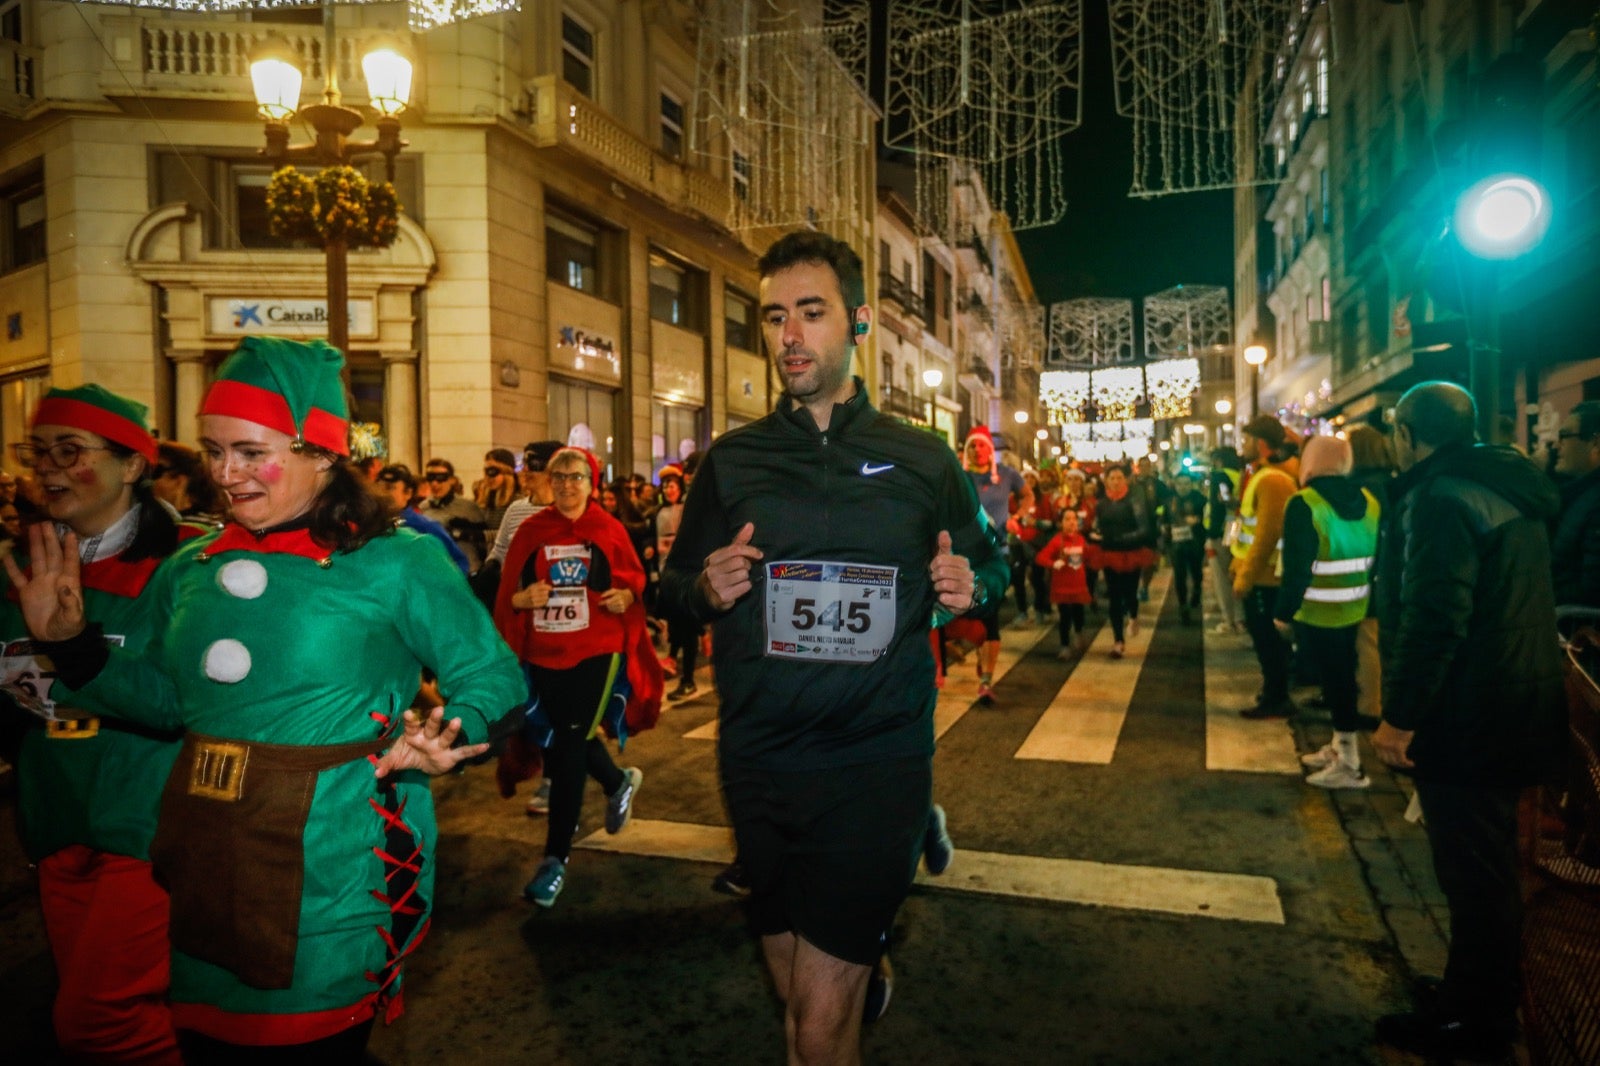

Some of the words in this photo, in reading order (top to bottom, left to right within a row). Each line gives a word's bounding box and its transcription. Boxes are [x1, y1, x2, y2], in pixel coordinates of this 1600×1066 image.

[267, 306, 352, 322] CaixaB
[543, 605, 576, 621] 776
[791, 598, 871, 634] 545
[798, 635, 816, 643] DANIEL
